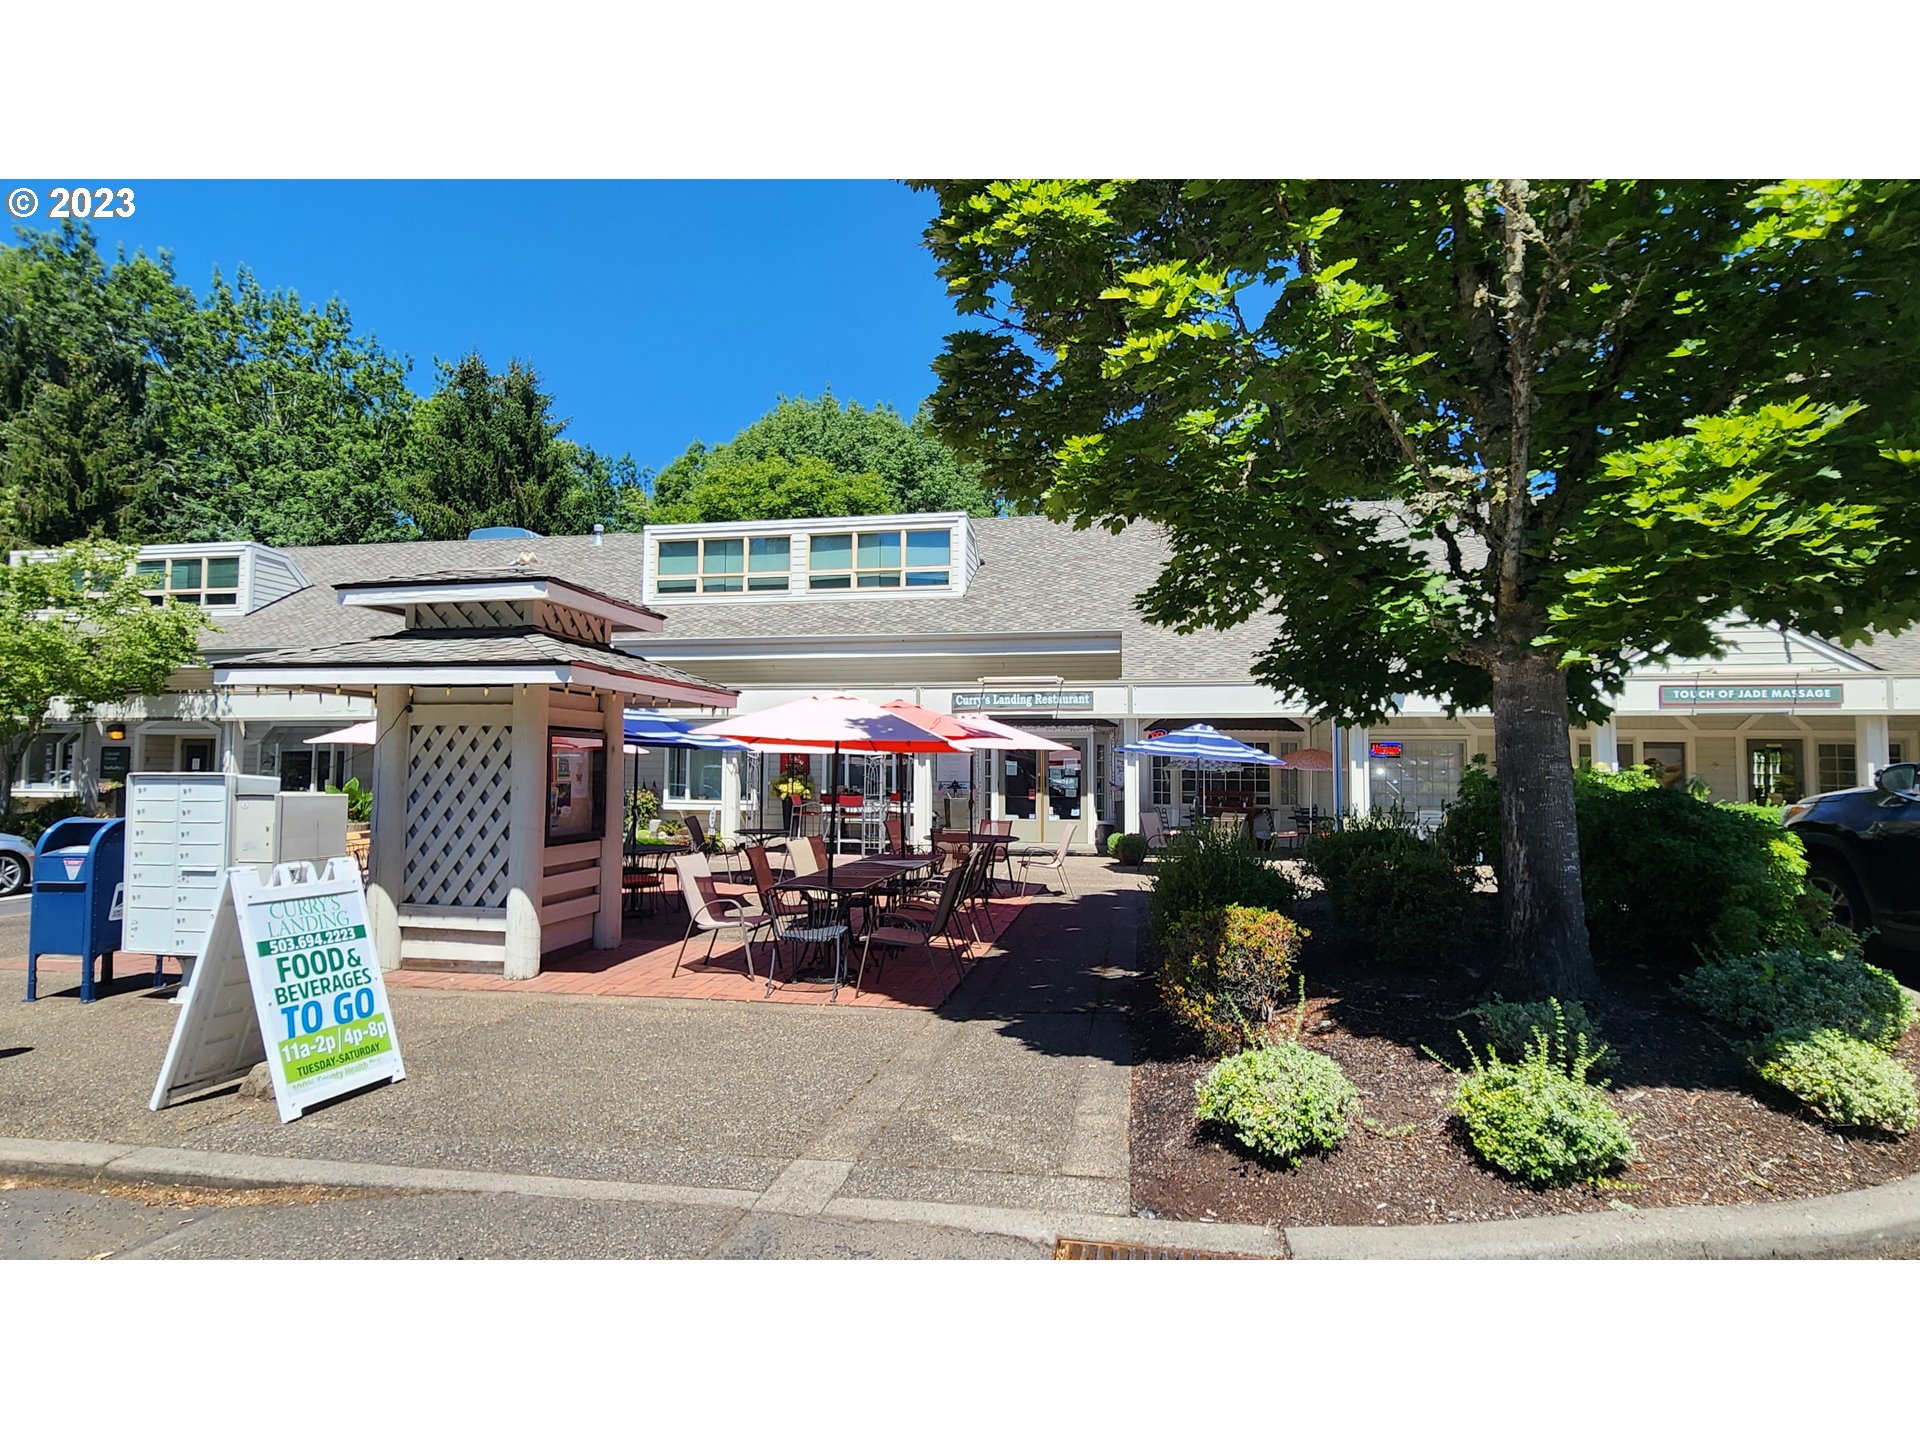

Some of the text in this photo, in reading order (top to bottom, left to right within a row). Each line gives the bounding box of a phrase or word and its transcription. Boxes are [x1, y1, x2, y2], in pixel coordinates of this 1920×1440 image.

[955, 693, 1090, 708] Curry's Landing Restaurant
[1673, 689, 1832, 699] TOUCH OF JADE MASSAGE
[269, 895, 341, 919] CURRY'S
[267, 910, 350, 938] LANDING
[269, 927, 356, 954] 503.694.2223
[276, 947, 362, 983] FOOD &
[274, 967, 372, 1006] BEVERAGES
[281, 987, 375, 1039] TO GO
[296, 1042, 380, 1077] TUESDAY-SATURDAY
